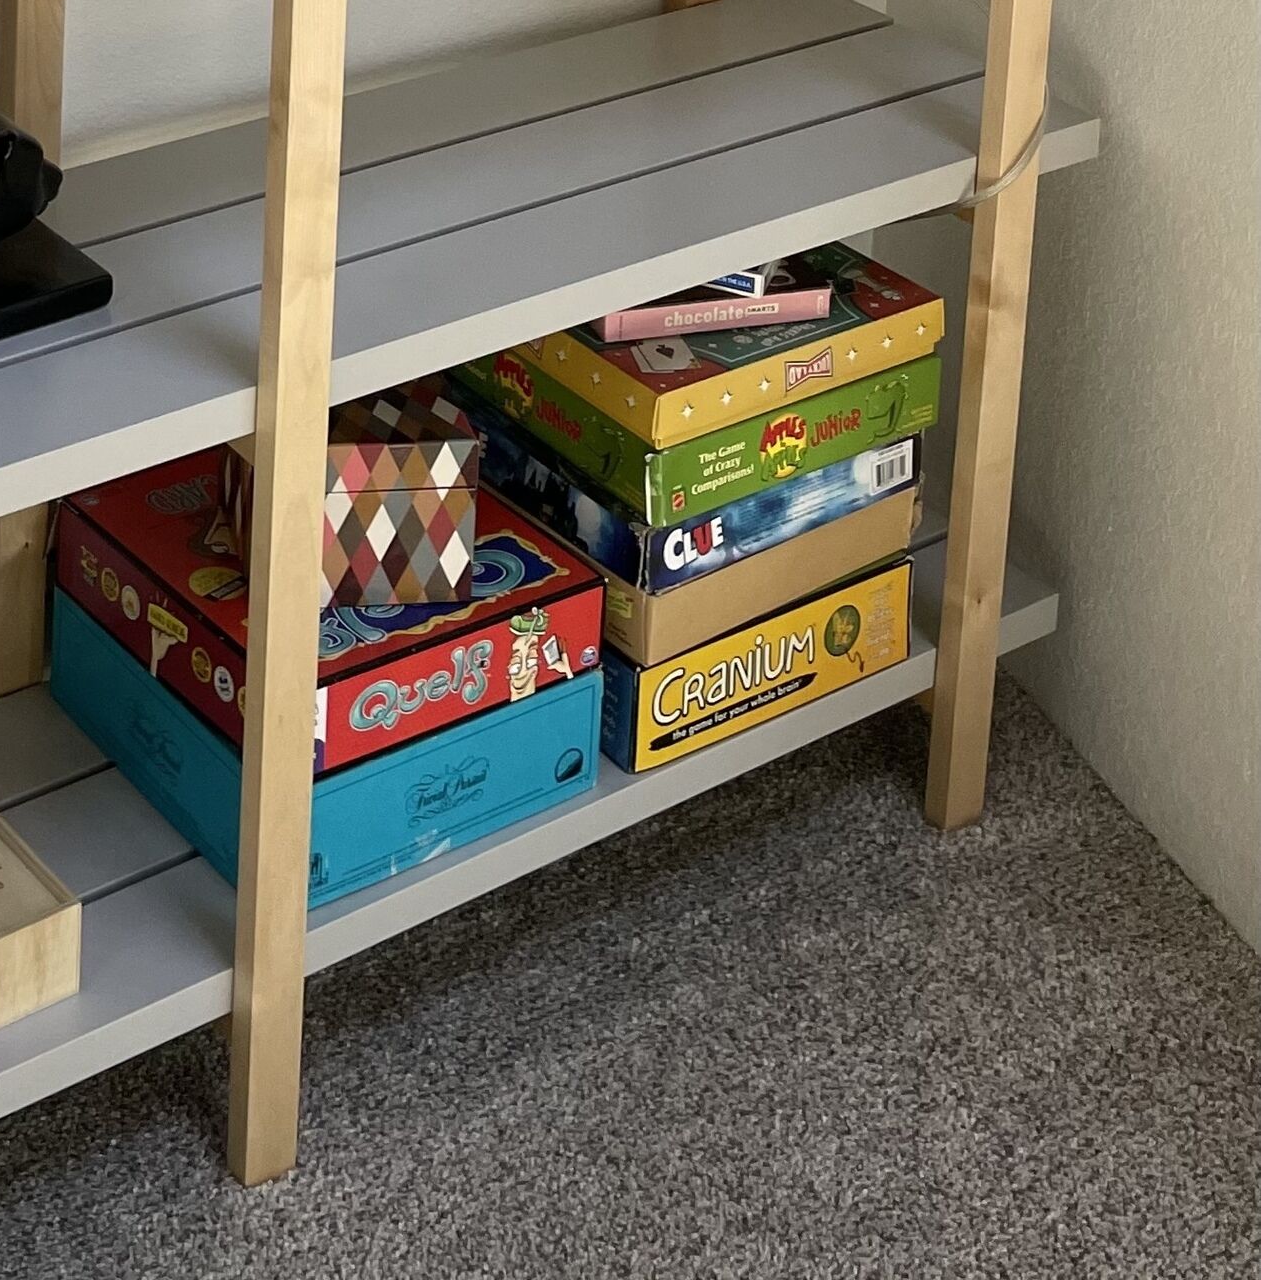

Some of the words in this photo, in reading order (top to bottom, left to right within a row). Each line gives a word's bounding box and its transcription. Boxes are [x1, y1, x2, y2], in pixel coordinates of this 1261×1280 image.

[664, 304, 744, 329] chocolate
[810, 408, 861, 448] JUNIOR
[698, 450, 717, 465] The
[718, 441, 746, 458] Game
[703, 465, 714, 477] of
[715, 457, 743, 475] Crazy
[691, 464, 755, 495] Comparisons!
[663, 516, 724, 571] CLUE
[348, 638, 494, 732] Quelf
[653, 625, 816, 726] CRANIUM
[672, 728, 687, 741] the
[689, 718, 714, 737] game
[714, 710, 728, 724] for
[728, 702, 749, 720] your
[750, 690, 777, 708] whole
